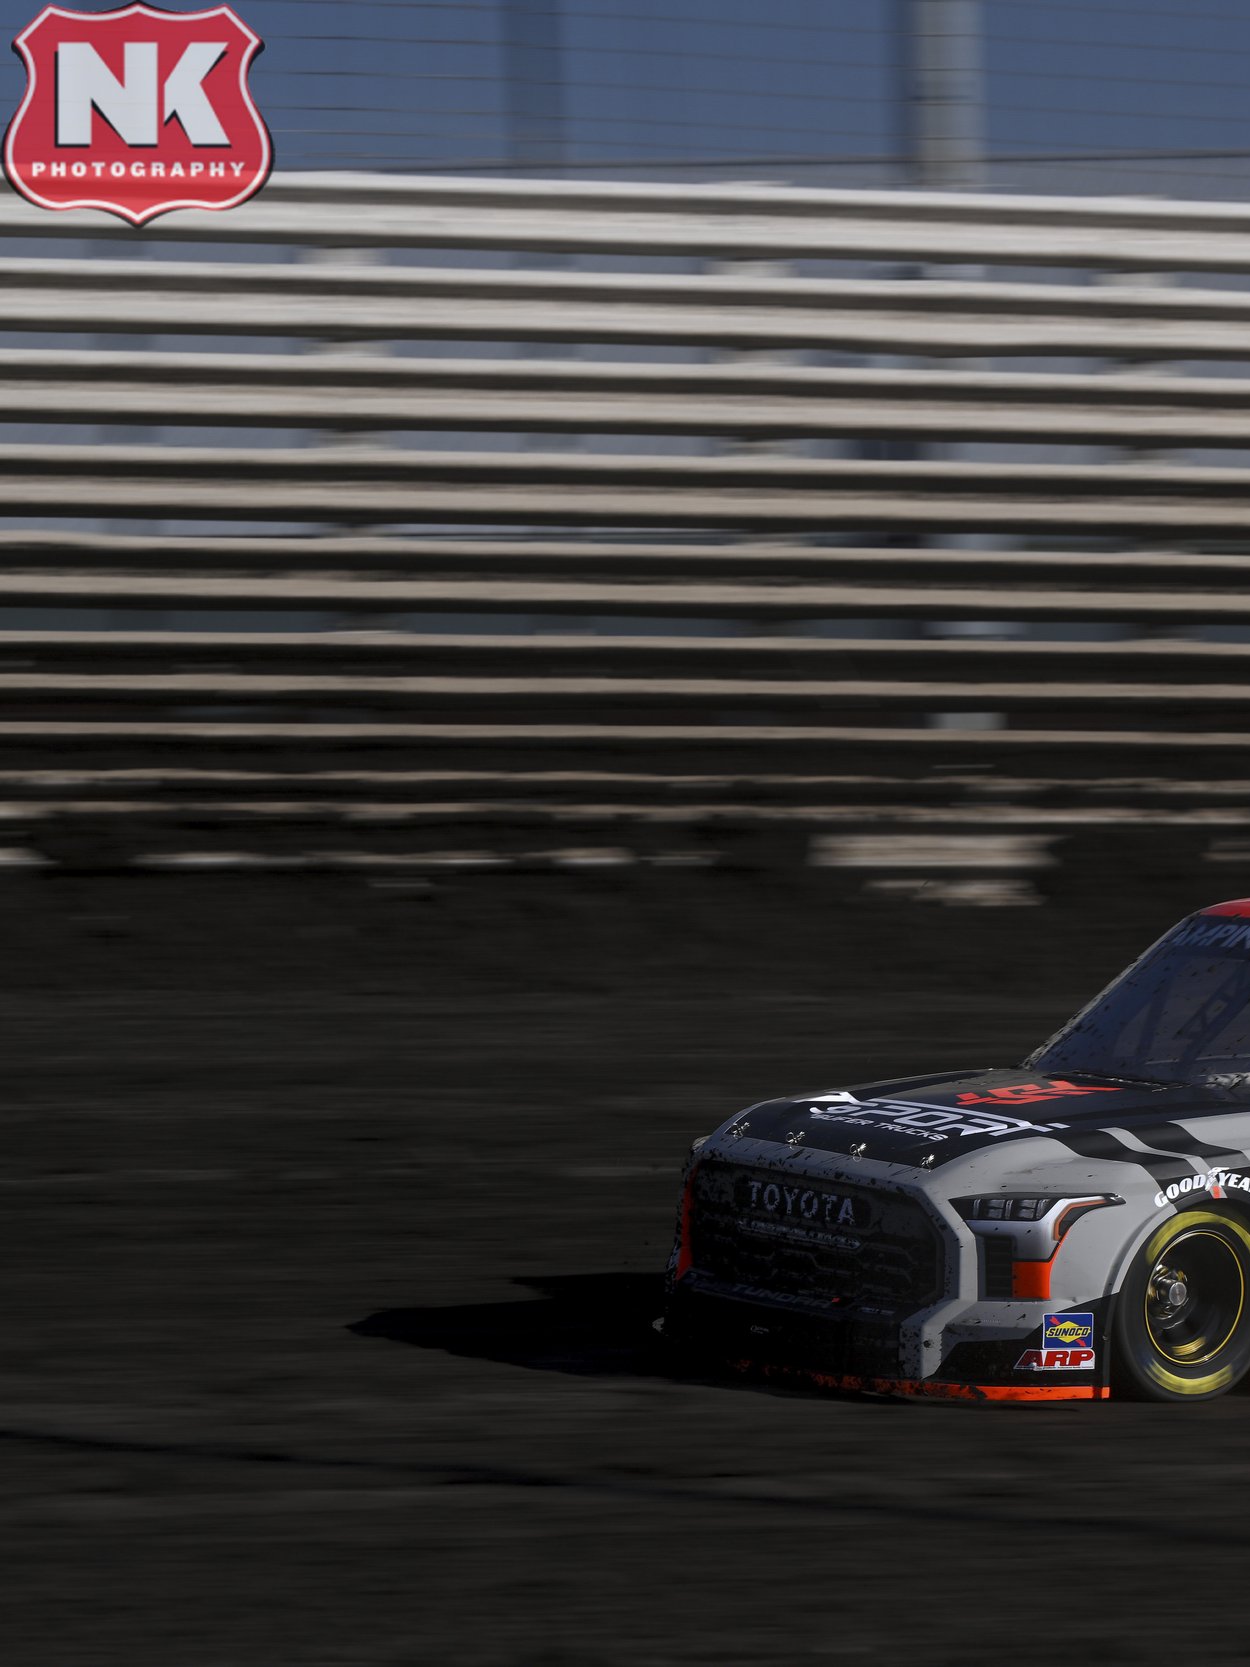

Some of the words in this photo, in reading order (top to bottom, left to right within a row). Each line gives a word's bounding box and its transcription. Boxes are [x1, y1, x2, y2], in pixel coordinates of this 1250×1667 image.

[873, 1122, 949, 1141] TRUCKS
[749, 1181, 857, 1226] TOYOTA
[1047, 1326, 1090, 1337] SUNOCO
[1014, 1350, 1094, 1368] ARP
